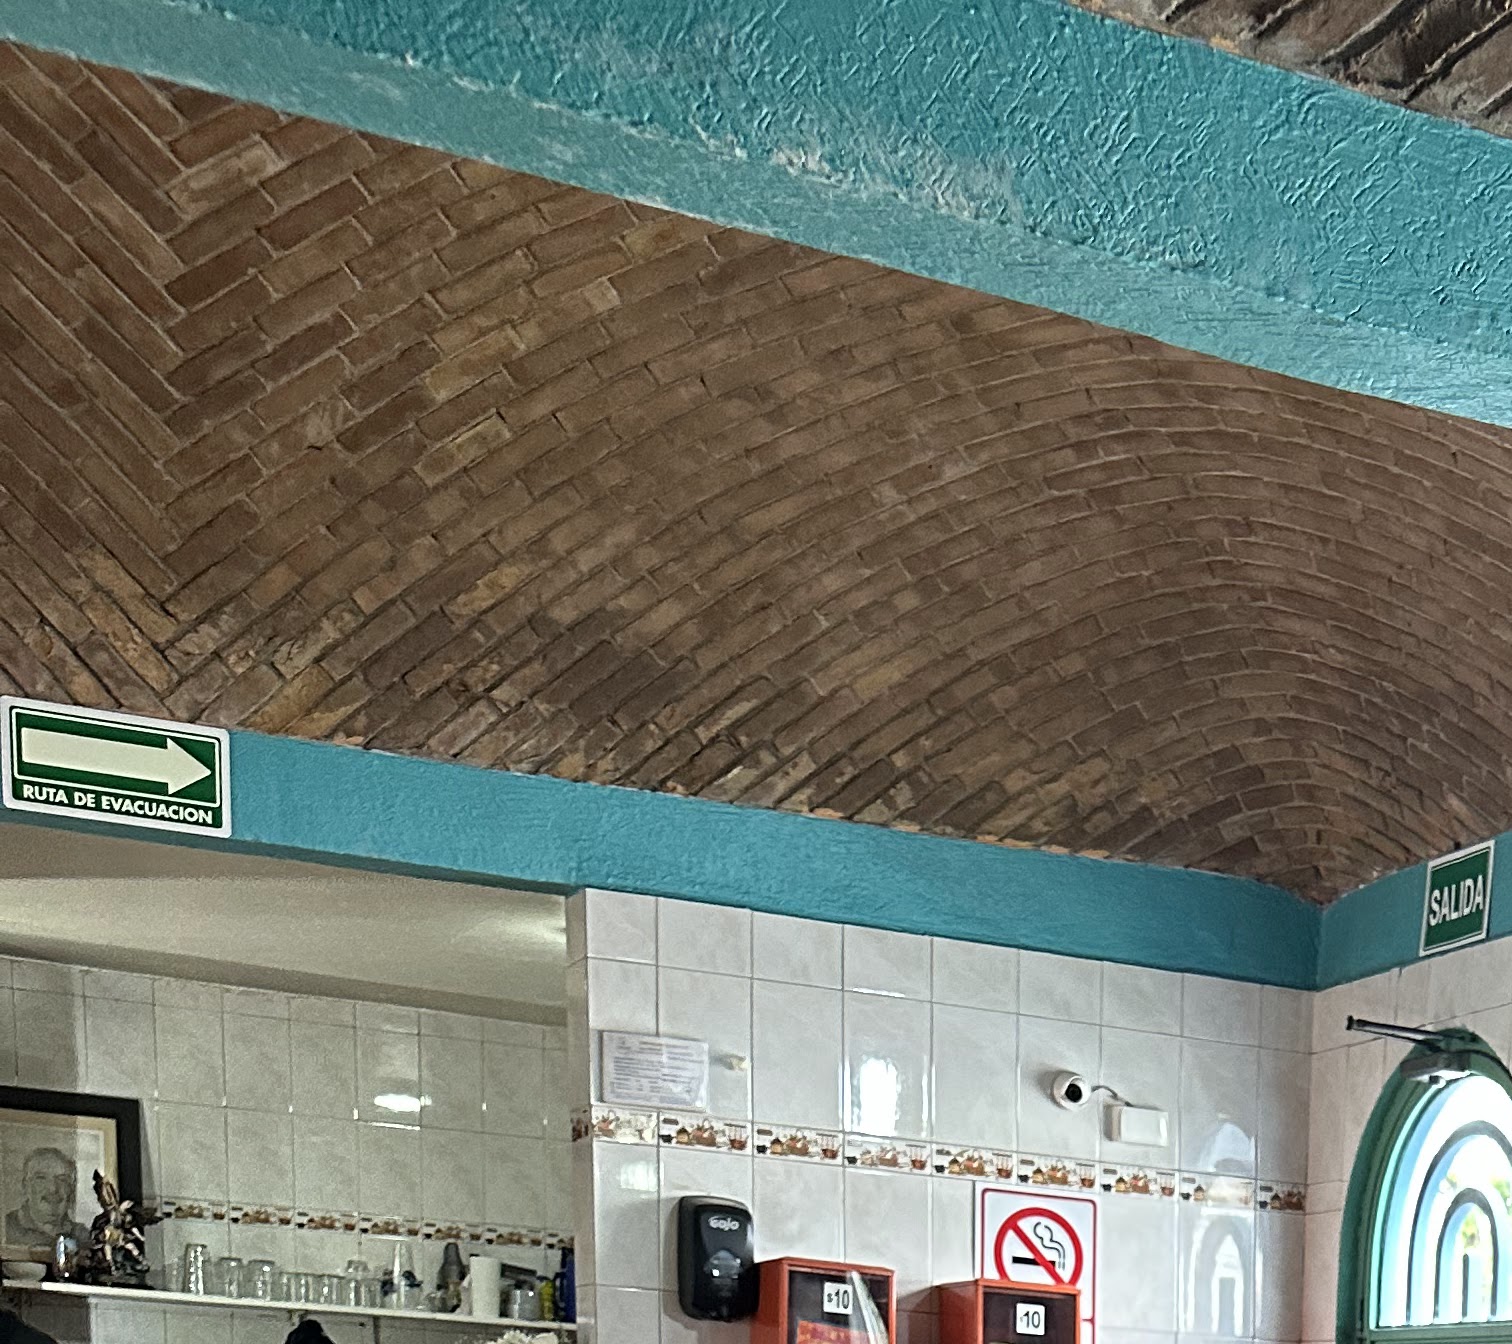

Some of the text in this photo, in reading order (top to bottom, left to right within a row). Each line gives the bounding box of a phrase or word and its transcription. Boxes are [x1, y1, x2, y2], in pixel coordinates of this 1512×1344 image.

[22, 783, 213, 825] RUTA DE EVACUACION
[1429, 874, 1485, 927] SALIDA
[826, 1288, 850, 1310] $10
